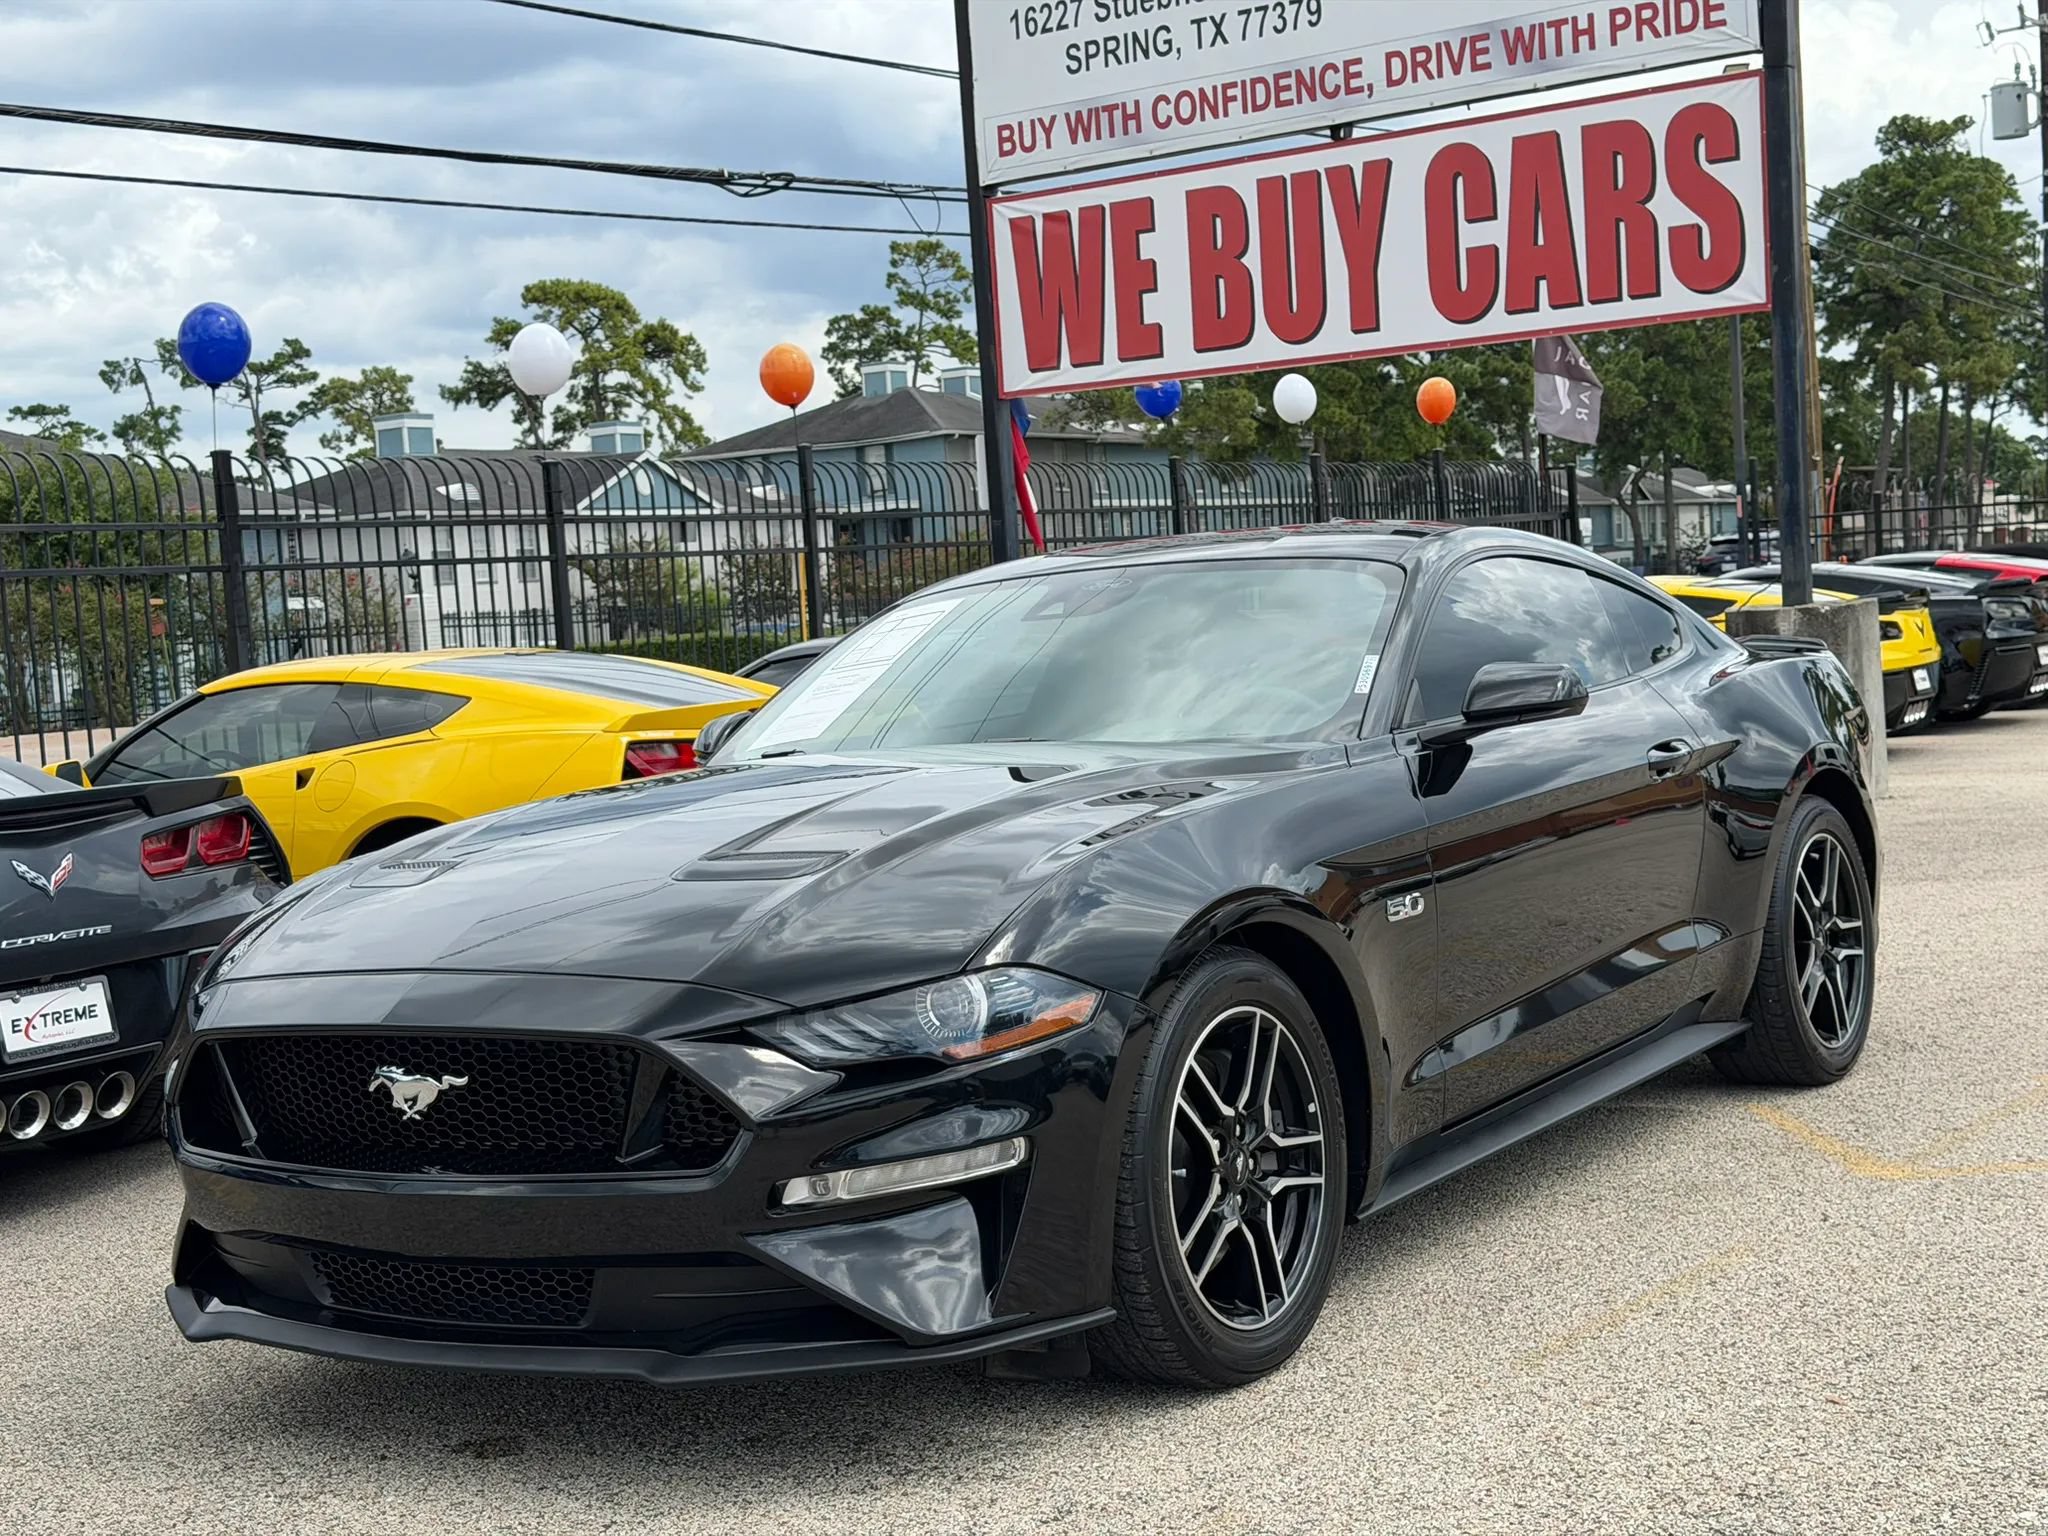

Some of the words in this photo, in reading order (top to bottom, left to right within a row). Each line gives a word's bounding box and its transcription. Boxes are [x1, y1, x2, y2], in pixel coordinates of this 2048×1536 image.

[1010, 0, 1083, 40] 16227
[1065, 25, 1182, 75] SPRING,
[1190, 13, 1229, 50] TX
[1237, 0, 1323, 42] 77379
[997, 114, 1058, 158] BUY
[1064, 100, 1142, 146] WITH
[1152, 57, 1375, 131] CONFIDENCE,
[1385, 33, 1492, 89] DRIVE
[1501, 12, 1596, 66] WITH
[1609, 0, 1727, 47] PRIDE
[1008, 196, 1164, 374] WE
[1185, 158, 1393, 354] BUY
[1424, 102, 1747, 325] CARS
[0, 924, 112, 949] CORVETTE
[11, 1003, 98, 1034] EXTREME
